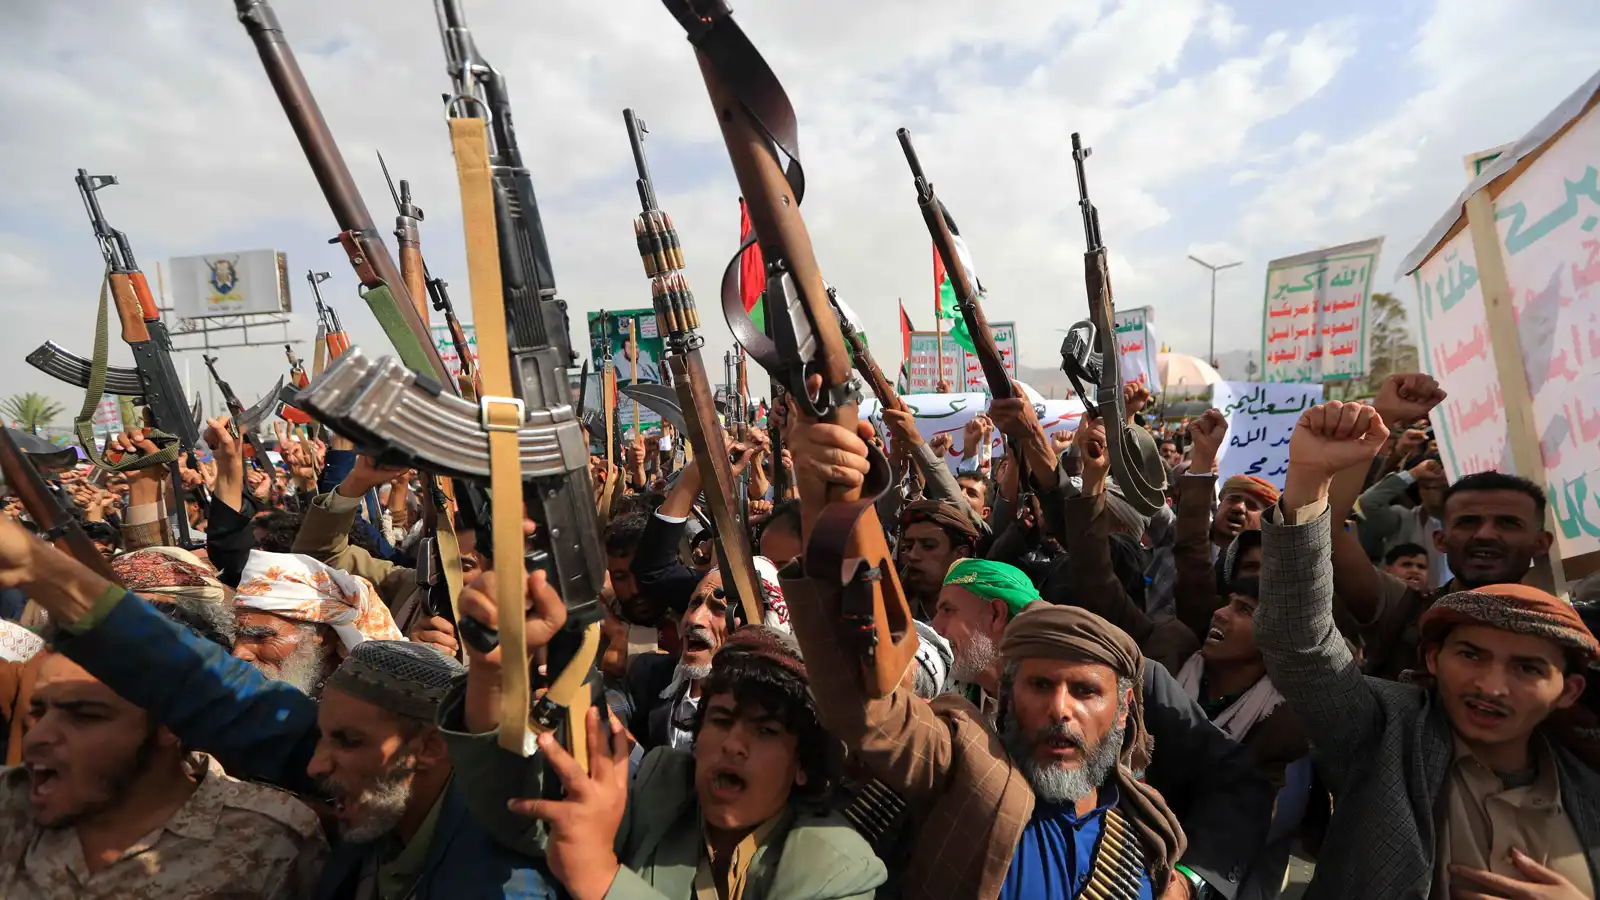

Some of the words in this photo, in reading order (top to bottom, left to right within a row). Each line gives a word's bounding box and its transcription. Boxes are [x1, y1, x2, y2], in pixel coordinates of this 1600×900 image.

[1330, 264, 1366, 287] الله
[1323, 292, 1362, 316] الموت
[1322, 316, 1359, 338] الموت
[1230, 427, 1267, 448] الله
[1270, 427, 1293, 447] ند
